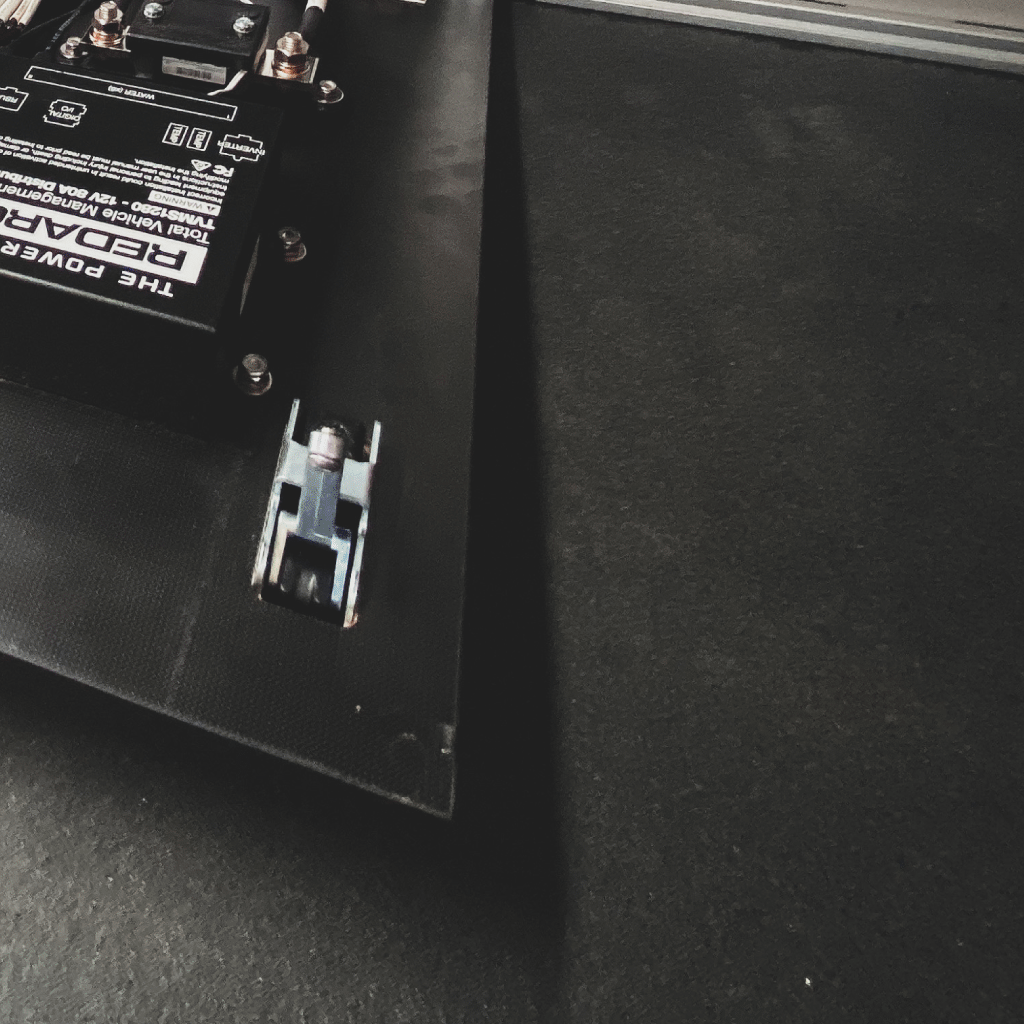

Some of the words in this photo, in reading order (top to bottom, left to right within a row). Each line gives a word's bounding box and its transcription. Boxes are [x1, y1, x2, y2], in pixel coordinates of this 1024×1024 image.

[124, 89, 155, 101] WATER
[61, 105, 75, 113] I/O
[48, 110, 80, 122] DIGITAL
[44, 146, 63, 154] prior
[62, 149, 80, 158] read
[217, 140, 265, 156] INVERTER
[13, 152, 48, 164] activation
[54, 154, 87, 166] including
[91, 156, 111, 165] must
[48, 160, 90, 173] unintended
[87, 161, 109, 171] injury
[110, 160, 140, 170] manual
[98, 171, 120, 180] result
[109, 166, 143, 178] personal
[176, 168, 190, 176] the
[191, 170, 230, 184] modifying
[121, 176, 143, 185] could
[153, 176, 182, 188] leading
[58, 184, 89, 199] 80A
[182, 183, 226, 196] equipment
[87, 192, 117, 206] 12V
[153, 193, 203, 210] WARNING
[101, 208, 163, 233] Vehicle
[130, 201, 216, 230] TVMS1280
[167, 223, 210, 245] Total
[0, 240, 106, 279] POWER
[117, 270, 174, 298] THE
